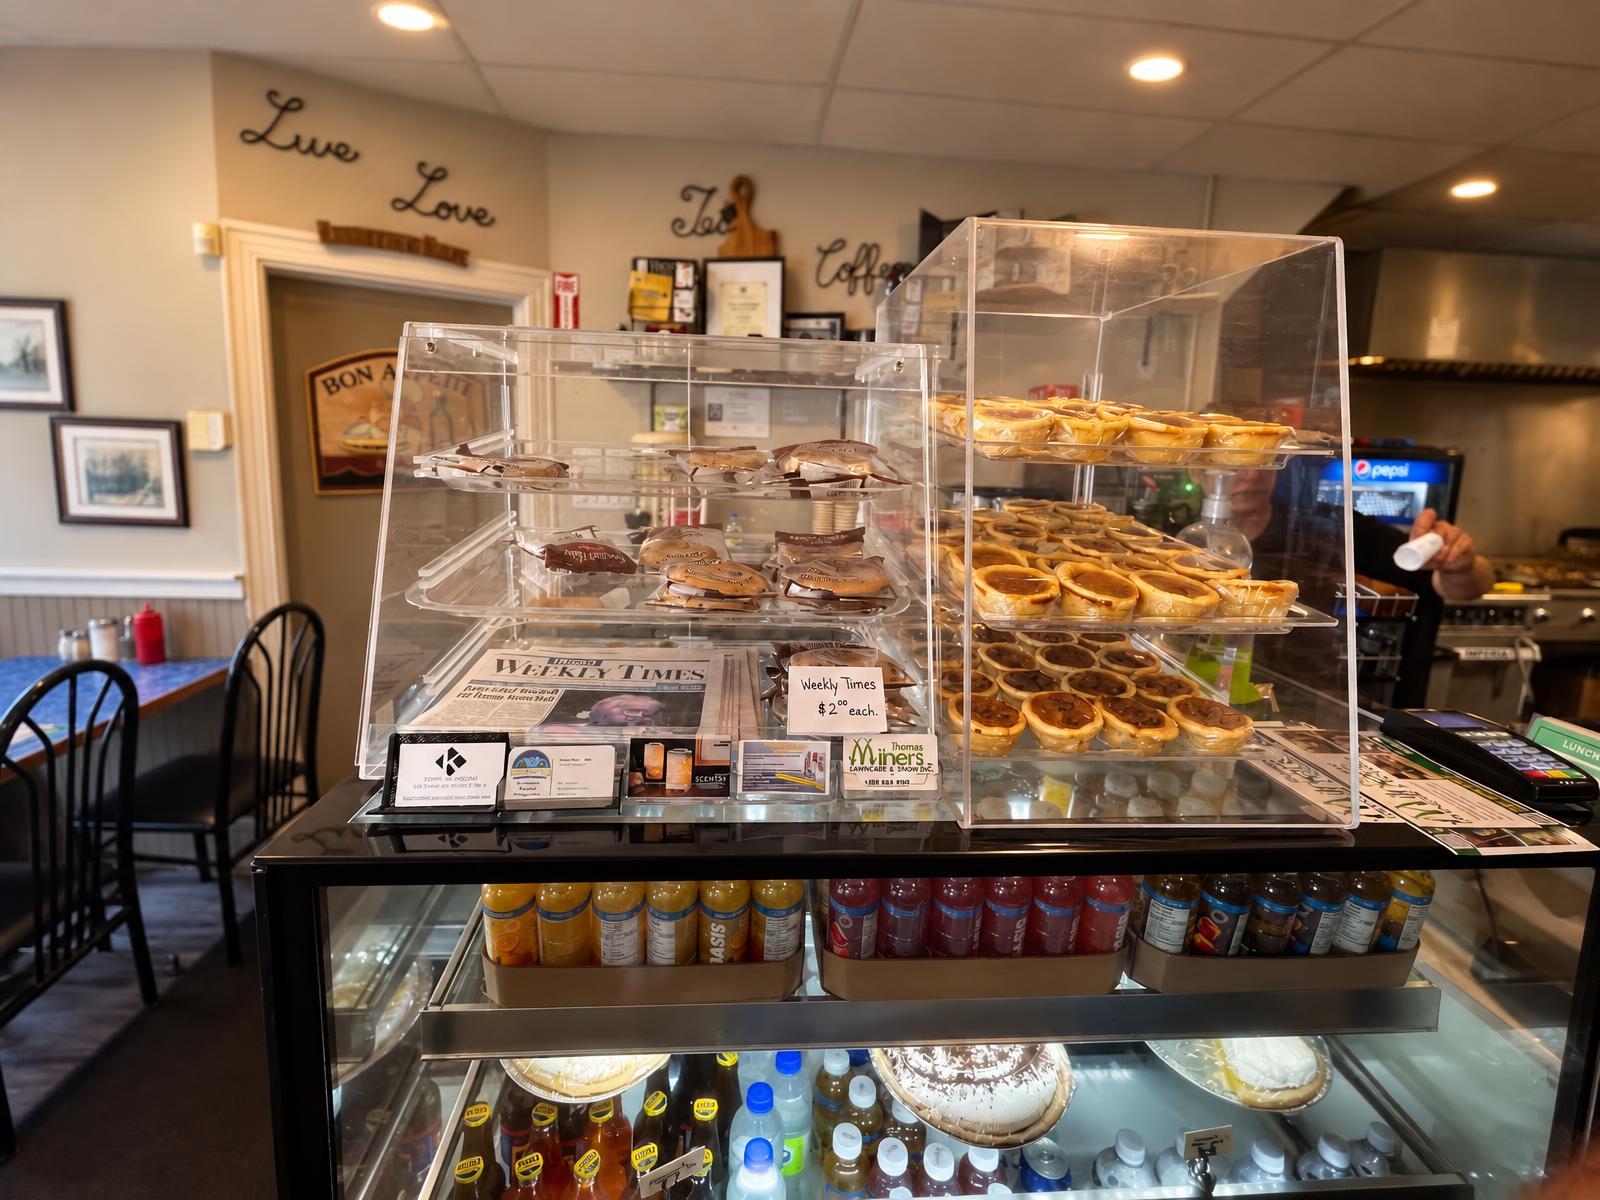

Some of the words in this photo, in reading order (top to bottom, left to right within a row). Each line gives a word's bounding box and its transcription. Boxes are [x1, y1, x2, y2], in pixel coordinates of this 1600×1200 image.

[240, 89, 361, 163] Live
[390, 160, 496, 227] Love
[816, 237, 908, 296] Coffe
[557, 280, 577, 294] FIRE
[322, 364, 374, 396] BON
[381, 362, 475, 398] AETIT
[1371, 463, 1410, 480] pepsi
[495, 658, 613, 680] WEEKLY
[618, 664, 706, 682] TIMES
[801, 678, 838, 696] Weekly
[840, 676, 876, 690] Times
[849, 704, 879, 716] each.
[848, 738, 924, 766] Miners
[891, 741, 924, 751] Thomas
[1562, 739, 1600, 761] LUNCH
